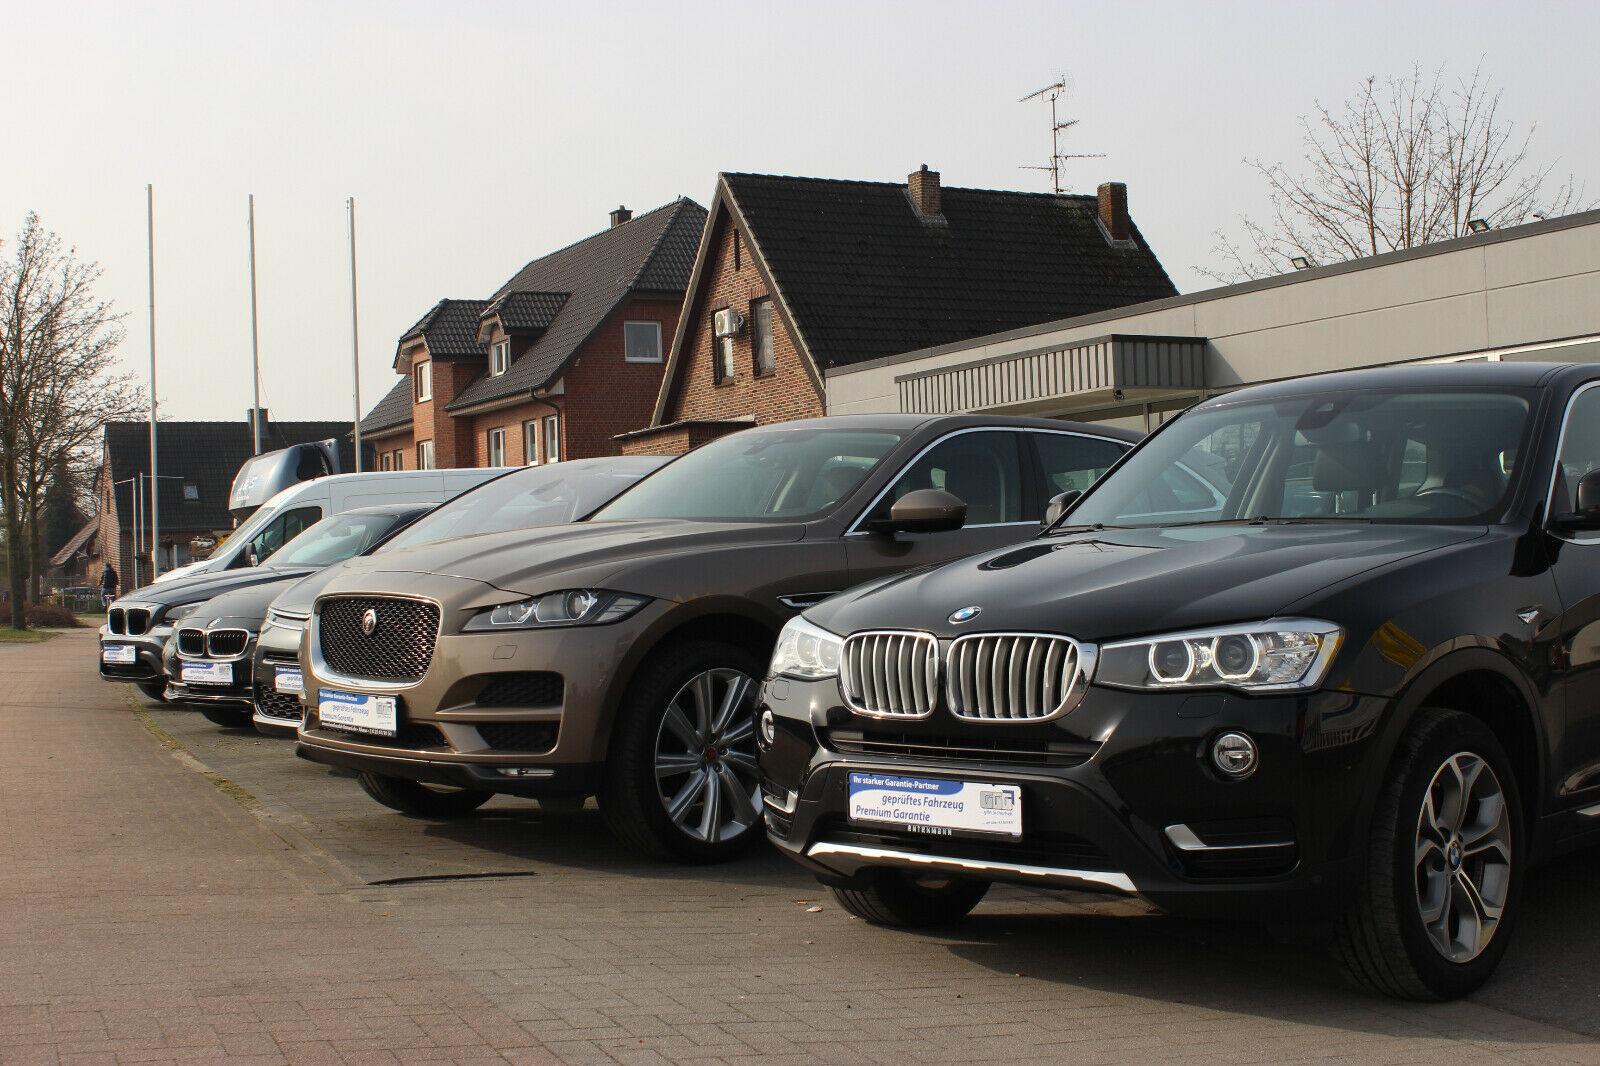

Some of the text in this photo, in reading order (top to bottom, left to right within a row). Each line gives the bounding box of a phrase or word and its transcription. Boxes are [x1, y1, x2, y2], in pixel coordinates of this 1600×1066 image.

[853, 775, 940, 790] Ihr starker Garantie-Partner
[882, 793, 922, 806] geprüftes
[923, 797, 964, 812] Fahrzeug
[855, 805, 930, 821] Premium Garantie
